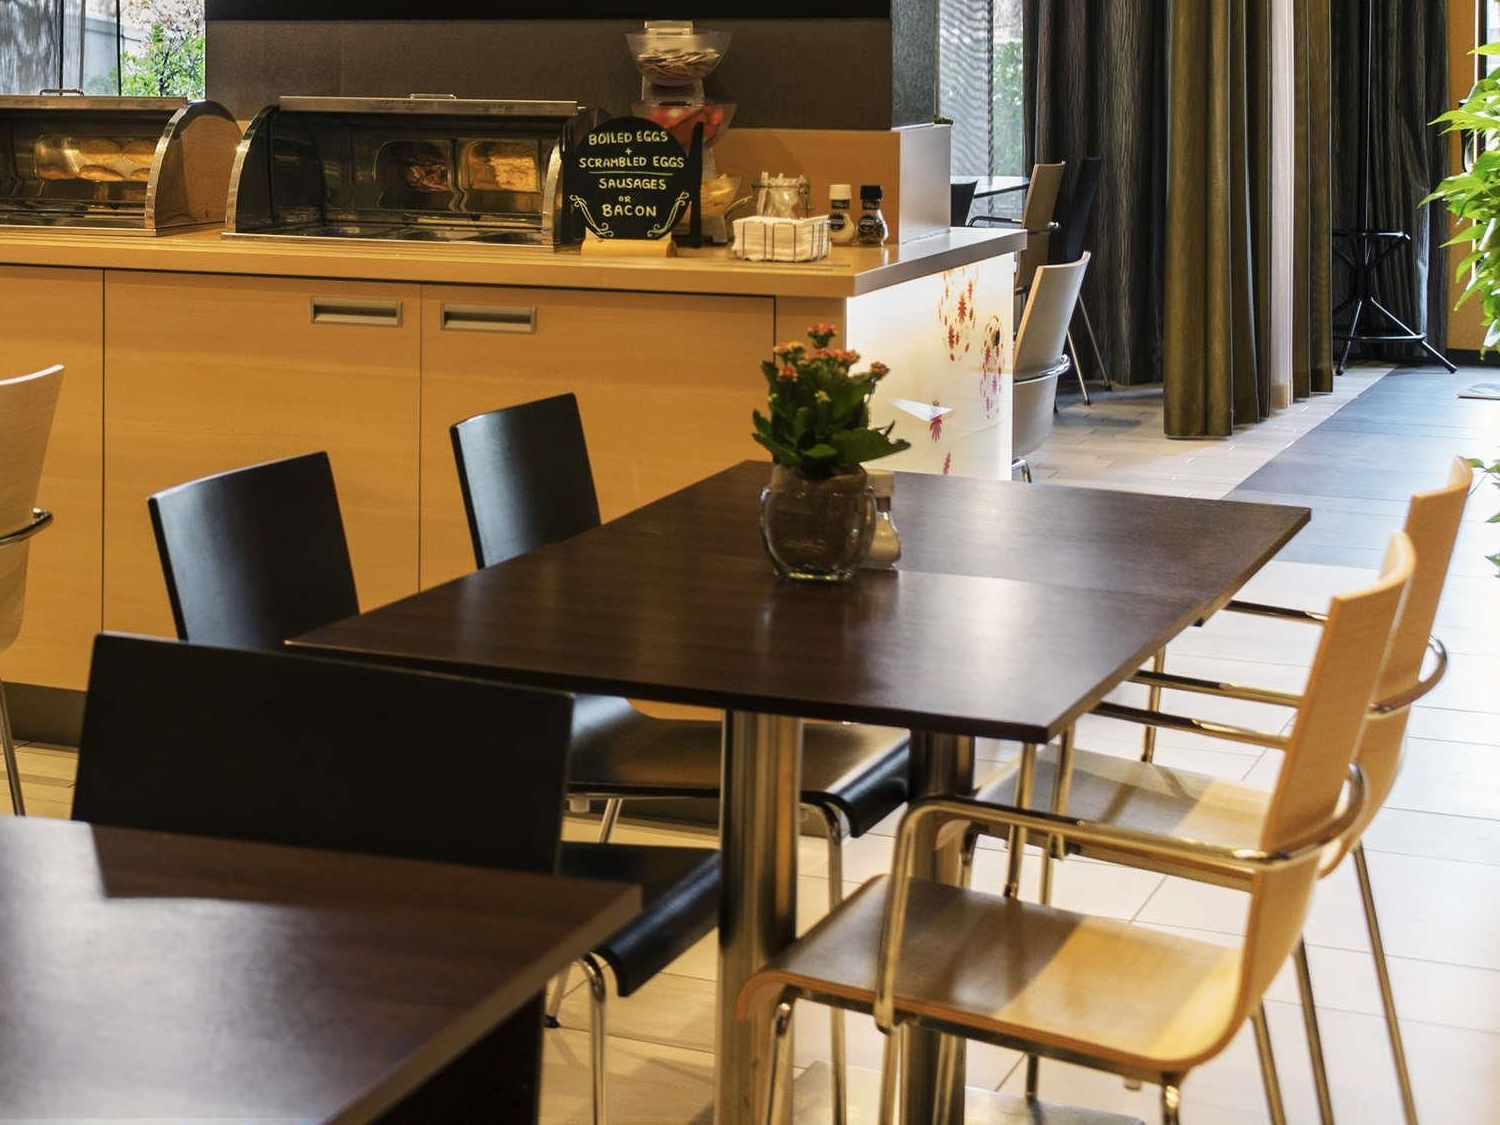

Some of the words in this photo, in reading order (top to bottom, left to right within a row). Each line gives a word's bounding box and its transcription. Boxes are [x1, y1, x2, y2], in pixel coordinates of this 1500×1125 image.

[588, 132, 632, 146] BOILED
[636, 131, 668, 143] EGGS
[579, 156, 647, 168] SCRAMBLED
[652, 156, 685, 169] EGGS
[598, 178, 667, 190] SAUSAGES
[602, 204, 657, 217] BACON
